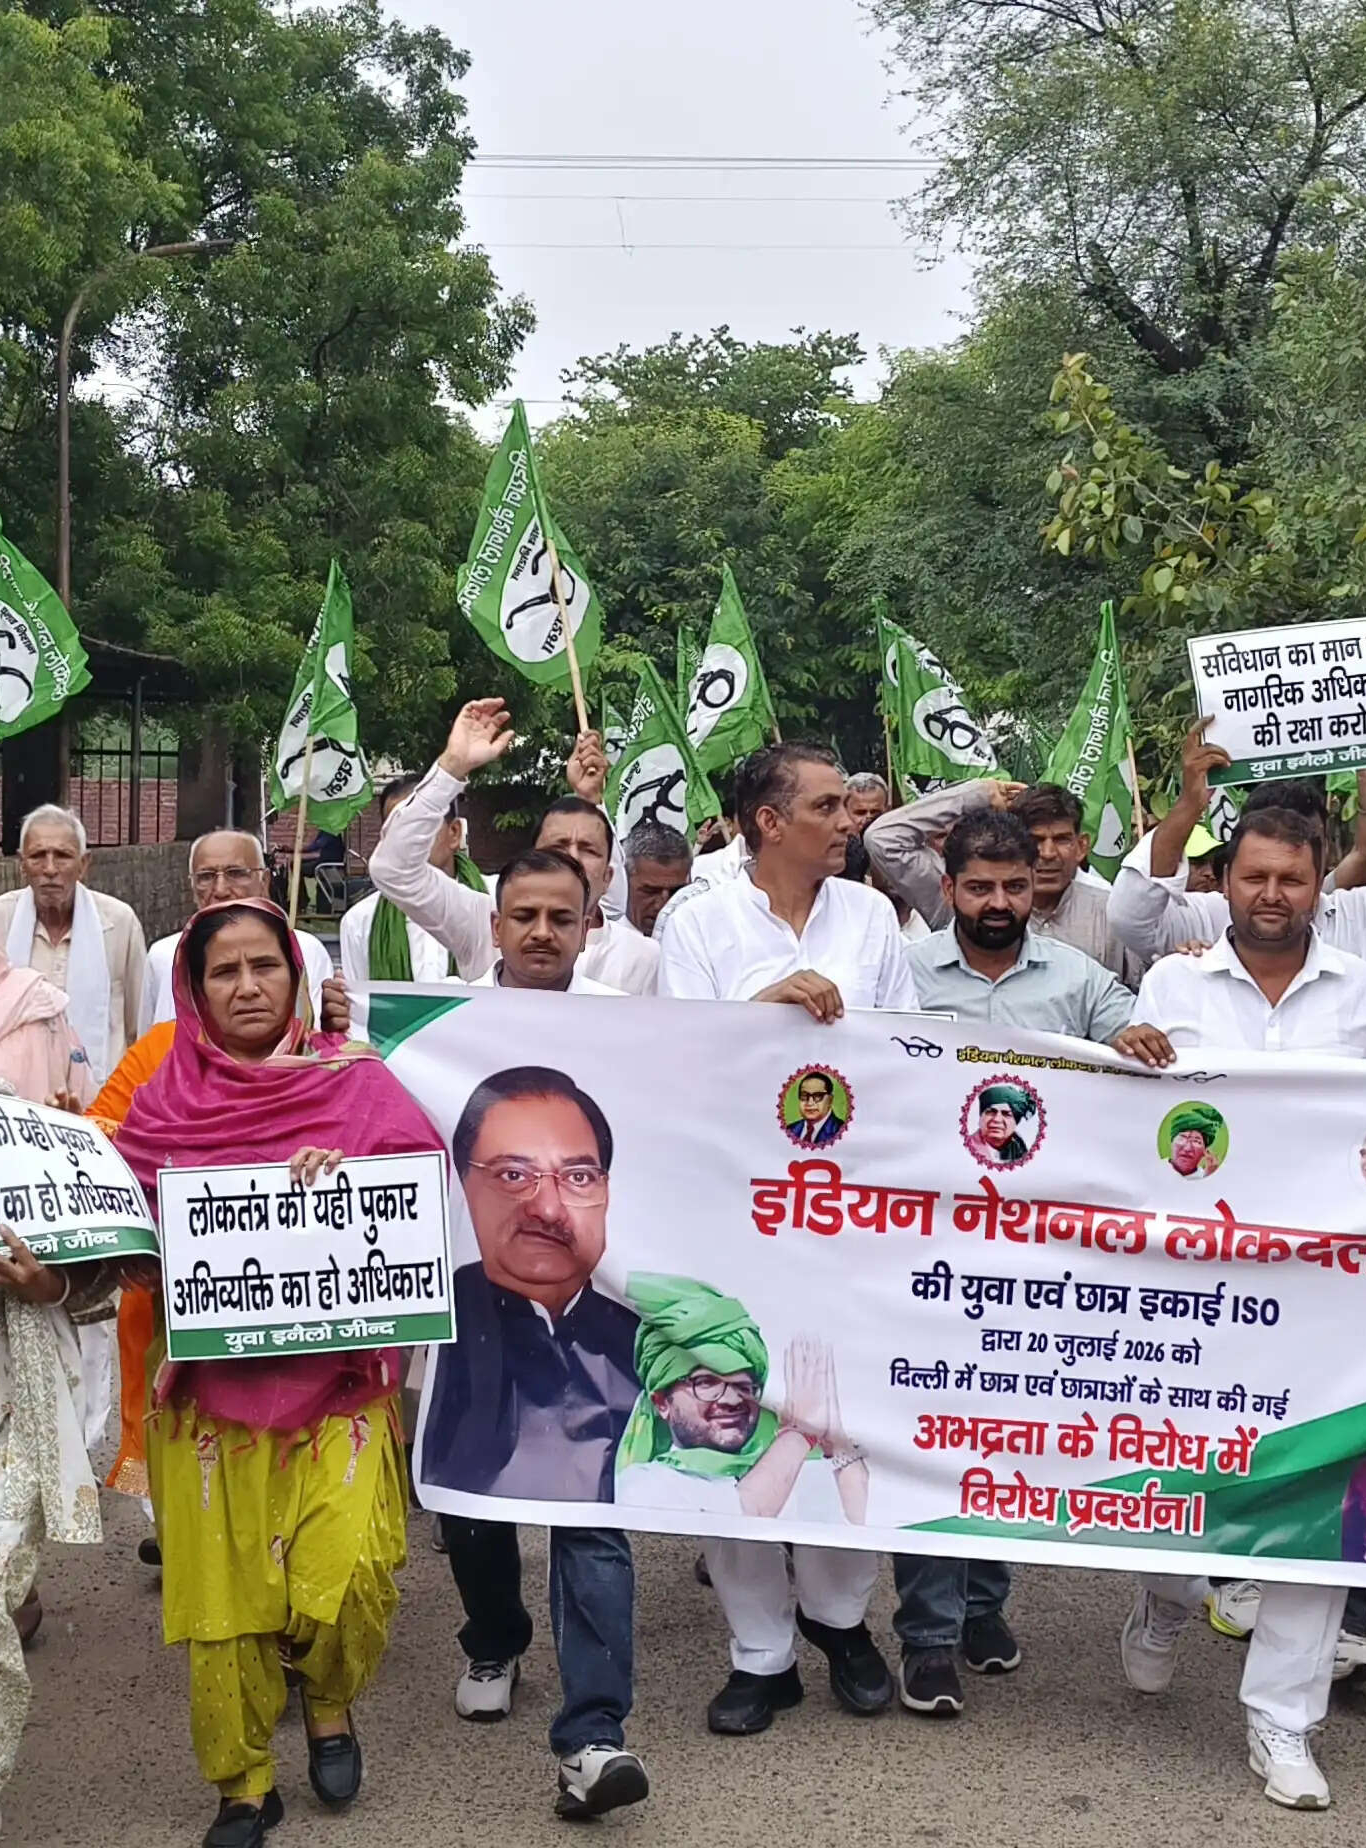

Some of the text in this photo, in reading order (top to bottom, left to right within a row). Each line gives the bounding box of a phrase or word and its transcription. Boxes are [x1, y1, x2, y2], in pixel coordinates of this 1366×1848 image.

[1200, 641, 1281, 678] संविधान
[1286, 642, 1316, 668] का
[1320, 637, 1362, 662] मान
[1223, 674, 1304, 712] नागरिक
[1253, 712, 1281, 747] की
[1287, 717, 1322, 744] रक्षा
[1249, 759, 1283, 778] युवा
[13, 1108, 55, 1152] यही
[50, 1121, 103, 1167] पुकार
[0, 1184, 34, 1223] का
[35, 1170, 63, 1223] हो
[187, 1171, 419, 1245] लोकतंत्र की यही पुकार
[953, 1175, 1157, 1255] नेशनल
[62, 1228, 119, 1250] जीन्द
[173, 1257, 274, 1316] अभिव्यक्ति
[279, 1270, 310, 1309] का
[316, 1253, 341, 1310] हो
[911, 1260, 1281, 1327] की युवा एवं छात्र इकाई ISO
[224, 1331, 266, 1353] युवा
[337, 1319, 397, 1338] जीन्द
[981, 1327, 1203, 1367] द्वारा 20 जुलाई 2026 को
[890, 1357, 1291, 1421] दिल्ली में छात्र एवं छात्राओं के साथ की गई
[913, 1411, 1259, 1475] अभद्रता के विरोध में
[958, 1467, 1060, 1522] विरोध
